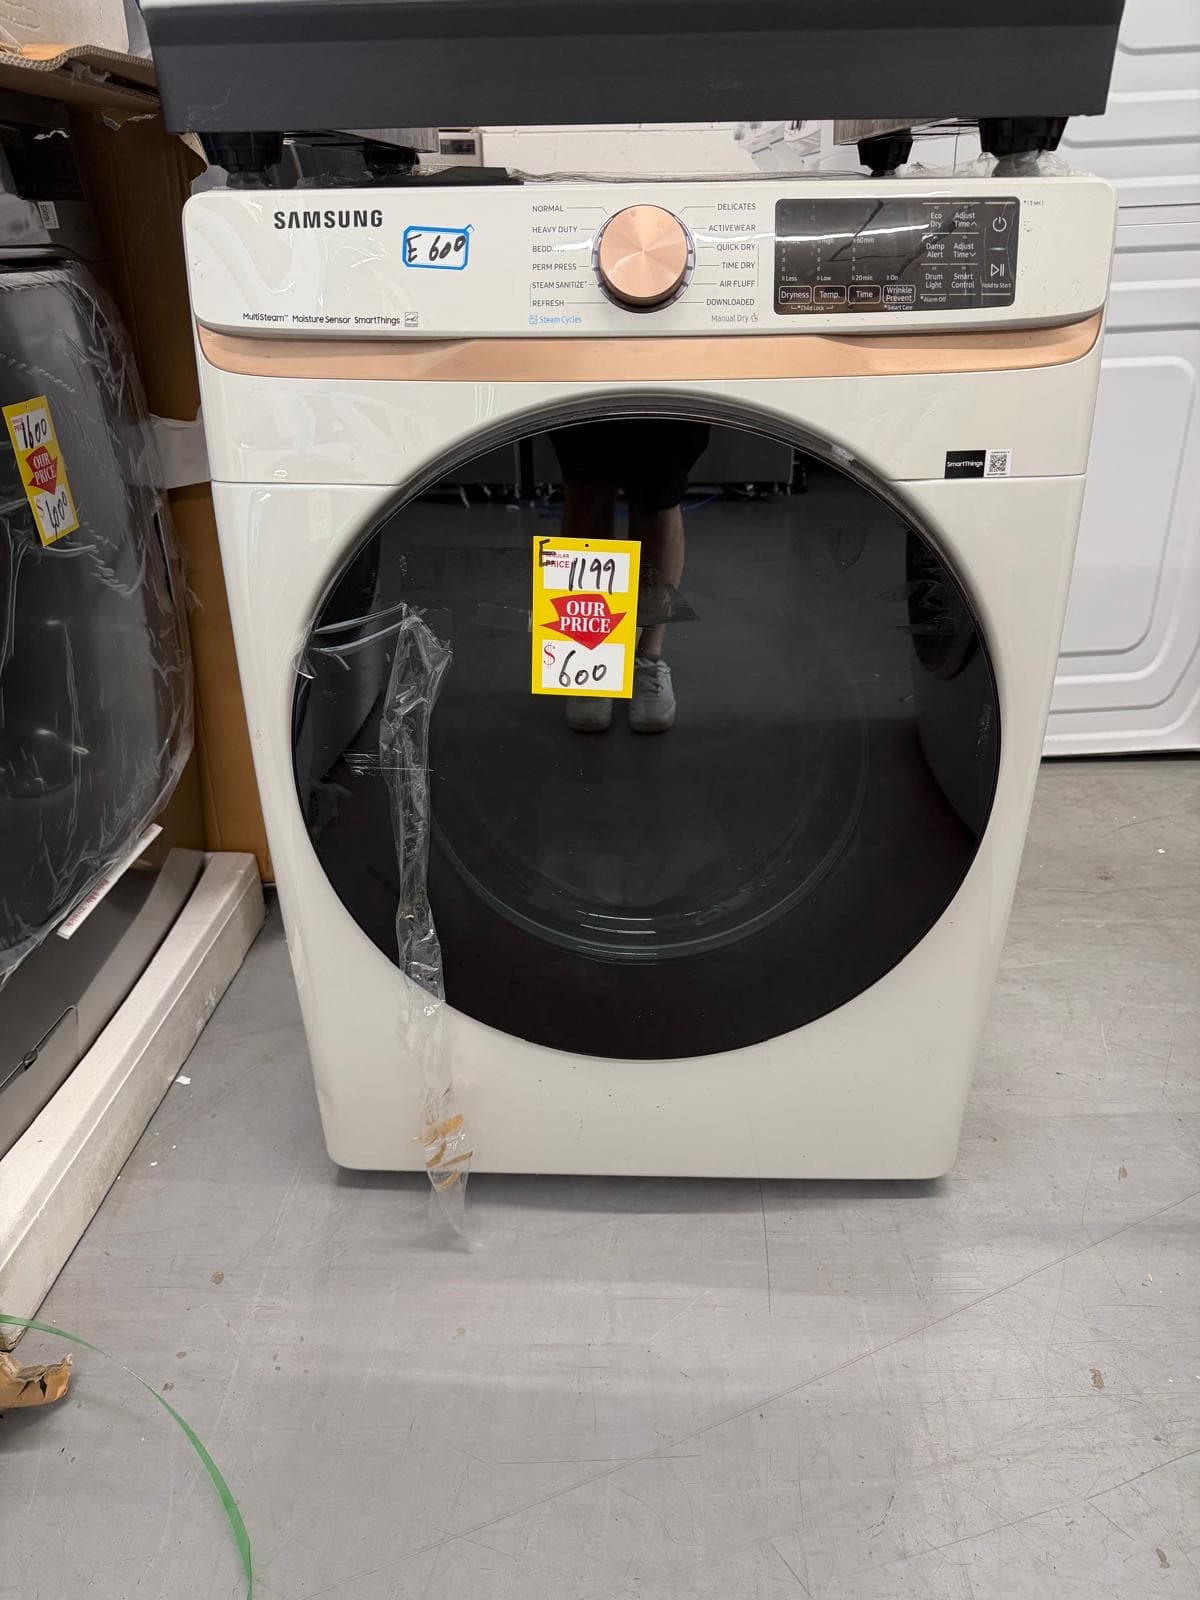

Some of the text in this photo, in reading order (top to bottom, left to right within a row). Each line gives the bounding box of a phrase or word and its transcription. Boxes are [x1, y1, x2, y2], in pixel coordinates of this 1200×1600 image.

[717, 202, 756, 211] DELICATES
[273, 209, 383, 229] SAMSUNG
[954, 212, 975, 220] Adjust
[532, 225, 578, 233] HEAVY DUTY
[407, 233, 466, 262] E 600
[716, 243, 739, 251] QUICK
[926, 243, 945, 251] Damp
[953, 243, 974, 251] Adjust
[532, 263, 553, 271] PERM
[722, 261, 756, 269] TIME DRY
[532, 281, 555, 289] STEAM
[925, 281, 942, 289] Light
[886, 286, 913, 294] Wrinkle
[781, 291, 809, 300] Dryness
[820, 291, 840, 300] Temp.
[886, 294, 913, 303] Prevent
[532, 299, 565, 307] REFRESH
[706, 298, 755, 306] DOWNLOADED
[292, 315, 324, 323] Moisture
[325, 315, 351, 324] Sensor
[354, 316, 400, 326] SmartThings
[539, 315, 583, 325] Steam Cycles
[737, 314, 749, 323] Dry
[33, 452, 50, 468] OUR
[34, 464, 56, 486] PRICE
[36, 499, 45, 519] $
[569, 557, 616, 595] 1199
[566, 600, 605, 617] OUR
[560, 617, 611, 633] PRICE
[543, 642, 607, 687] $ 600
